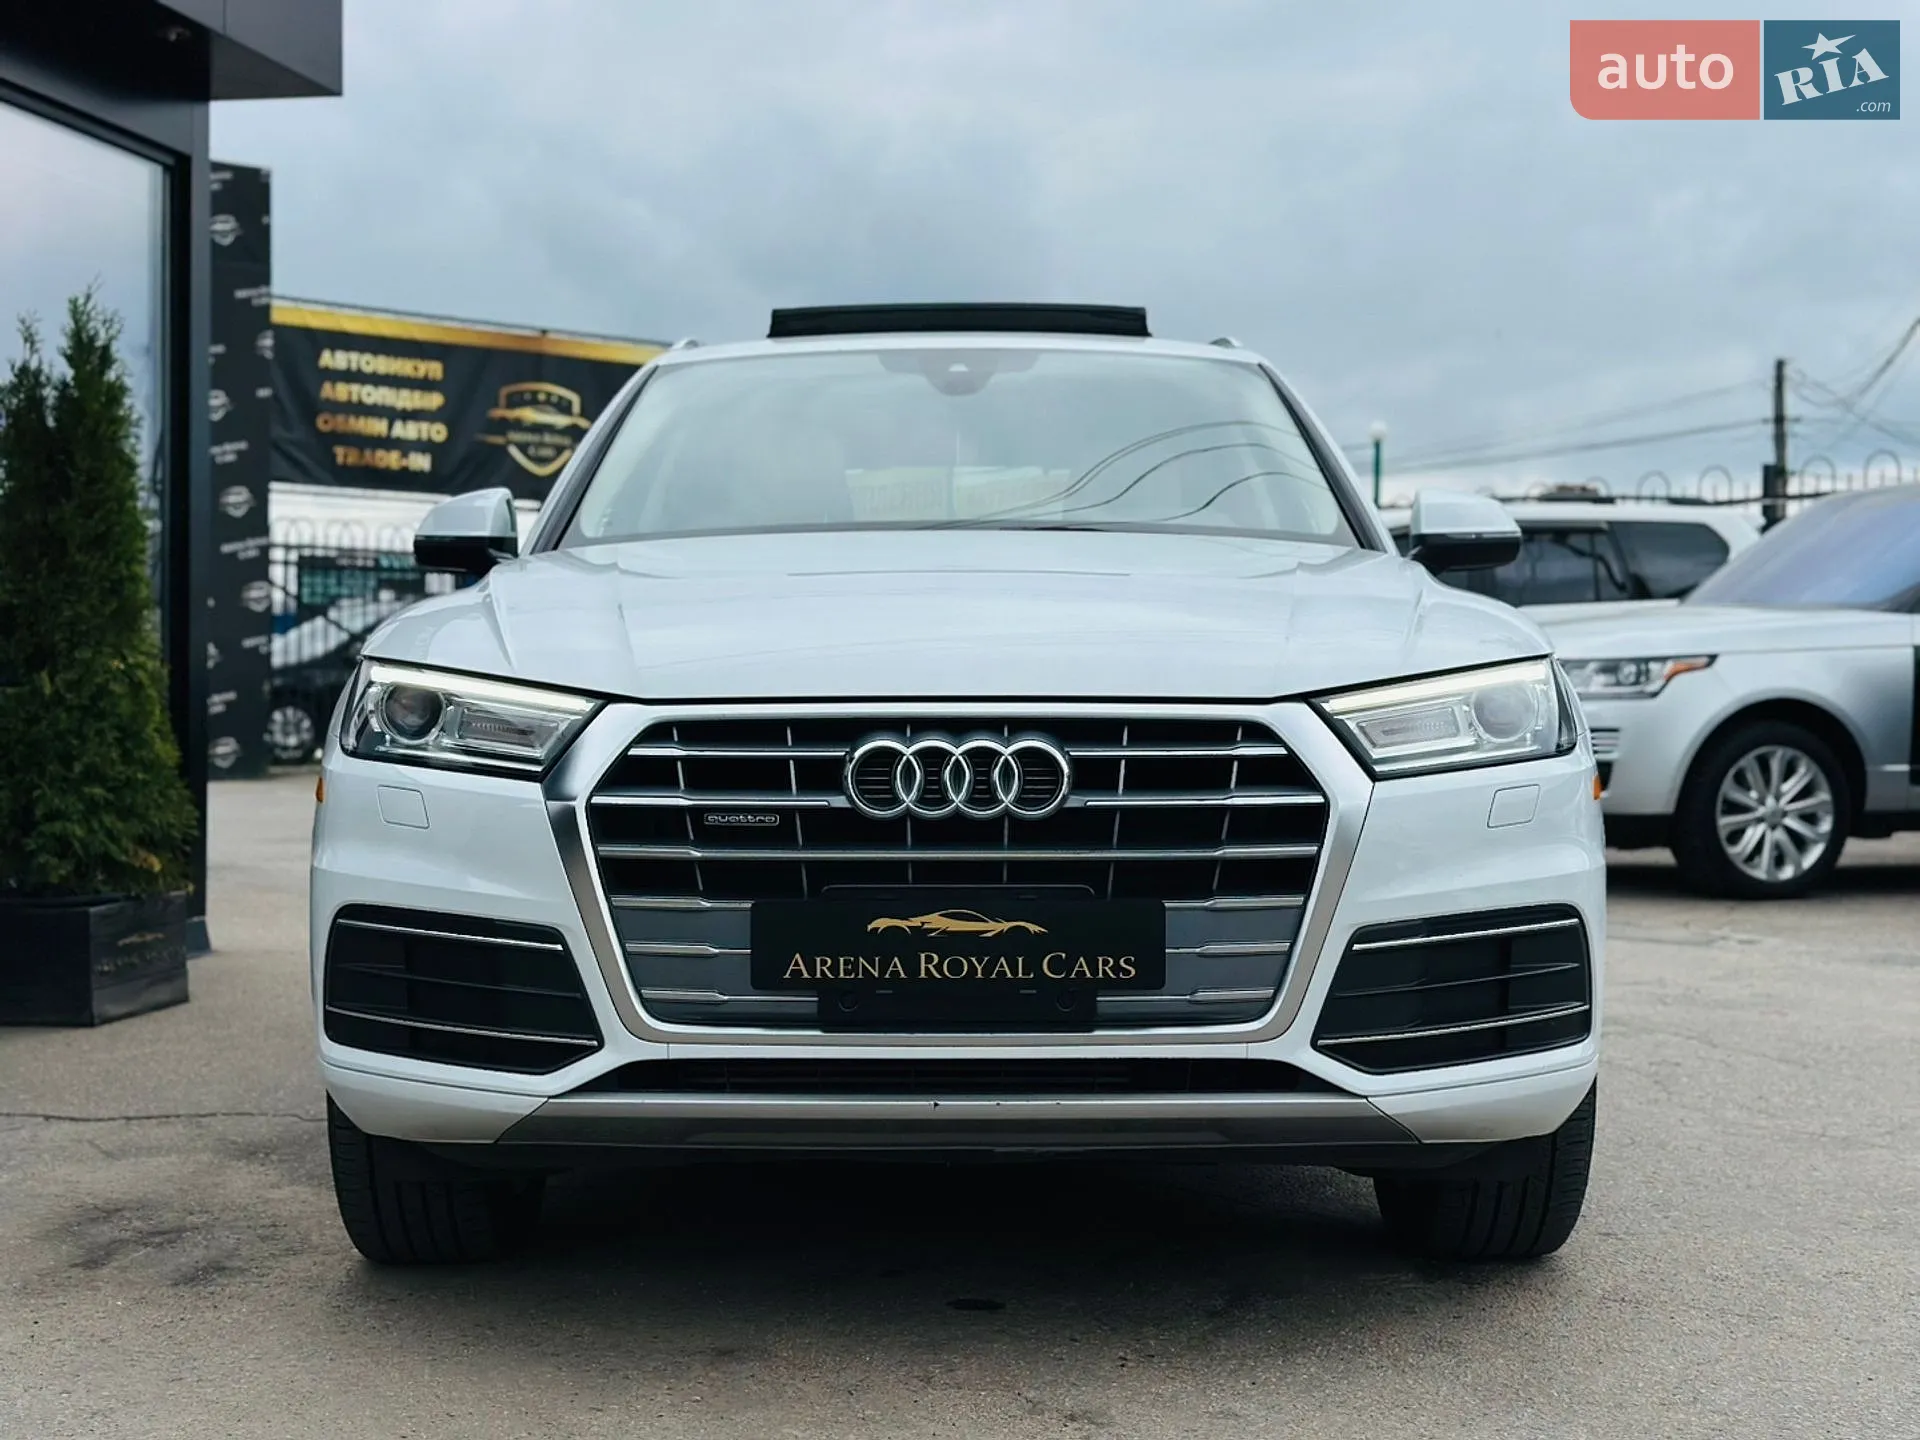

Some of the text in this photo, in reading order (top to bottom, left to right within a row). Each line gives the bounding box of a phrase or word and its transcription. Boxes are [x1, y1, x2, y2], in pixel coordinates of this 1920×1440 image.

[318, 348, 444, 382] АВТОВИКУП
[390, 418, 449, 443] АВТО
[332, 444, 432, 473] TRADE-IN
[707, 815, 776, 824] quattro
[783, 951, 1137, 979] ARENA ROYAL CARS
